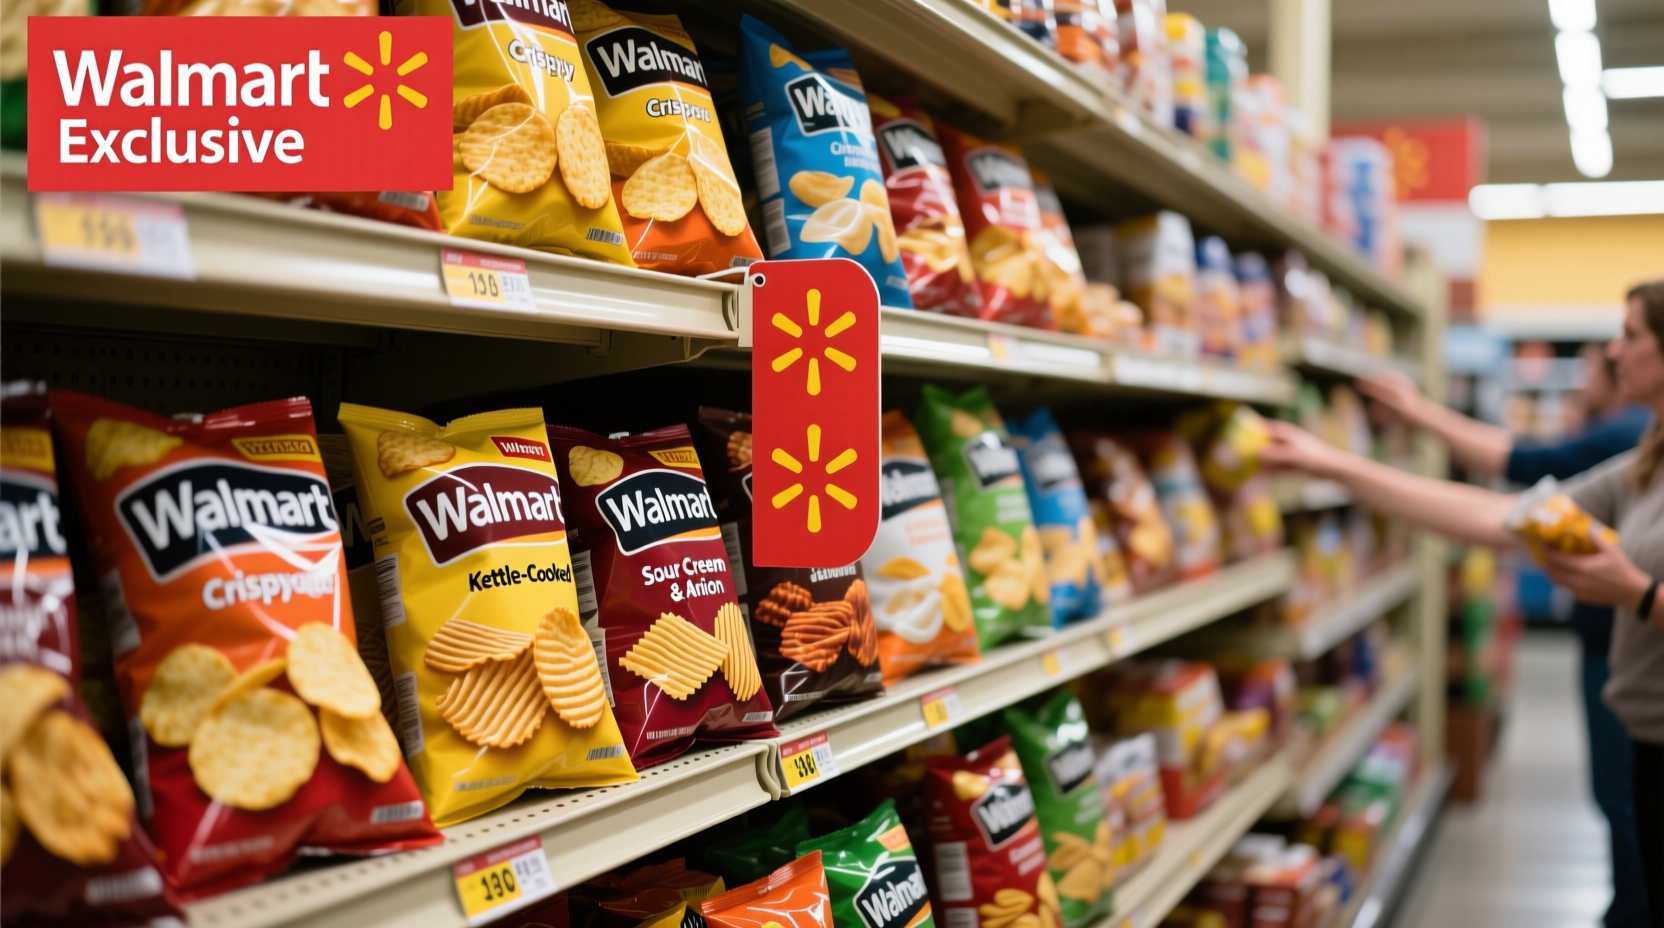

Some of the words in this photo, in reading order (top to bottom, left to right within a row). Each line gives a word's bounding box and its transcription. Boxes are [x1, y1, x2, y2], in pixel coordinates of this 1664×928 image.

[131, 479, 339, 550] Walmart
[468, 562, 572, 592] Kettle-Cooked
[641, 563, 681, 586] Sour
[670, 582, 686, 602] &
